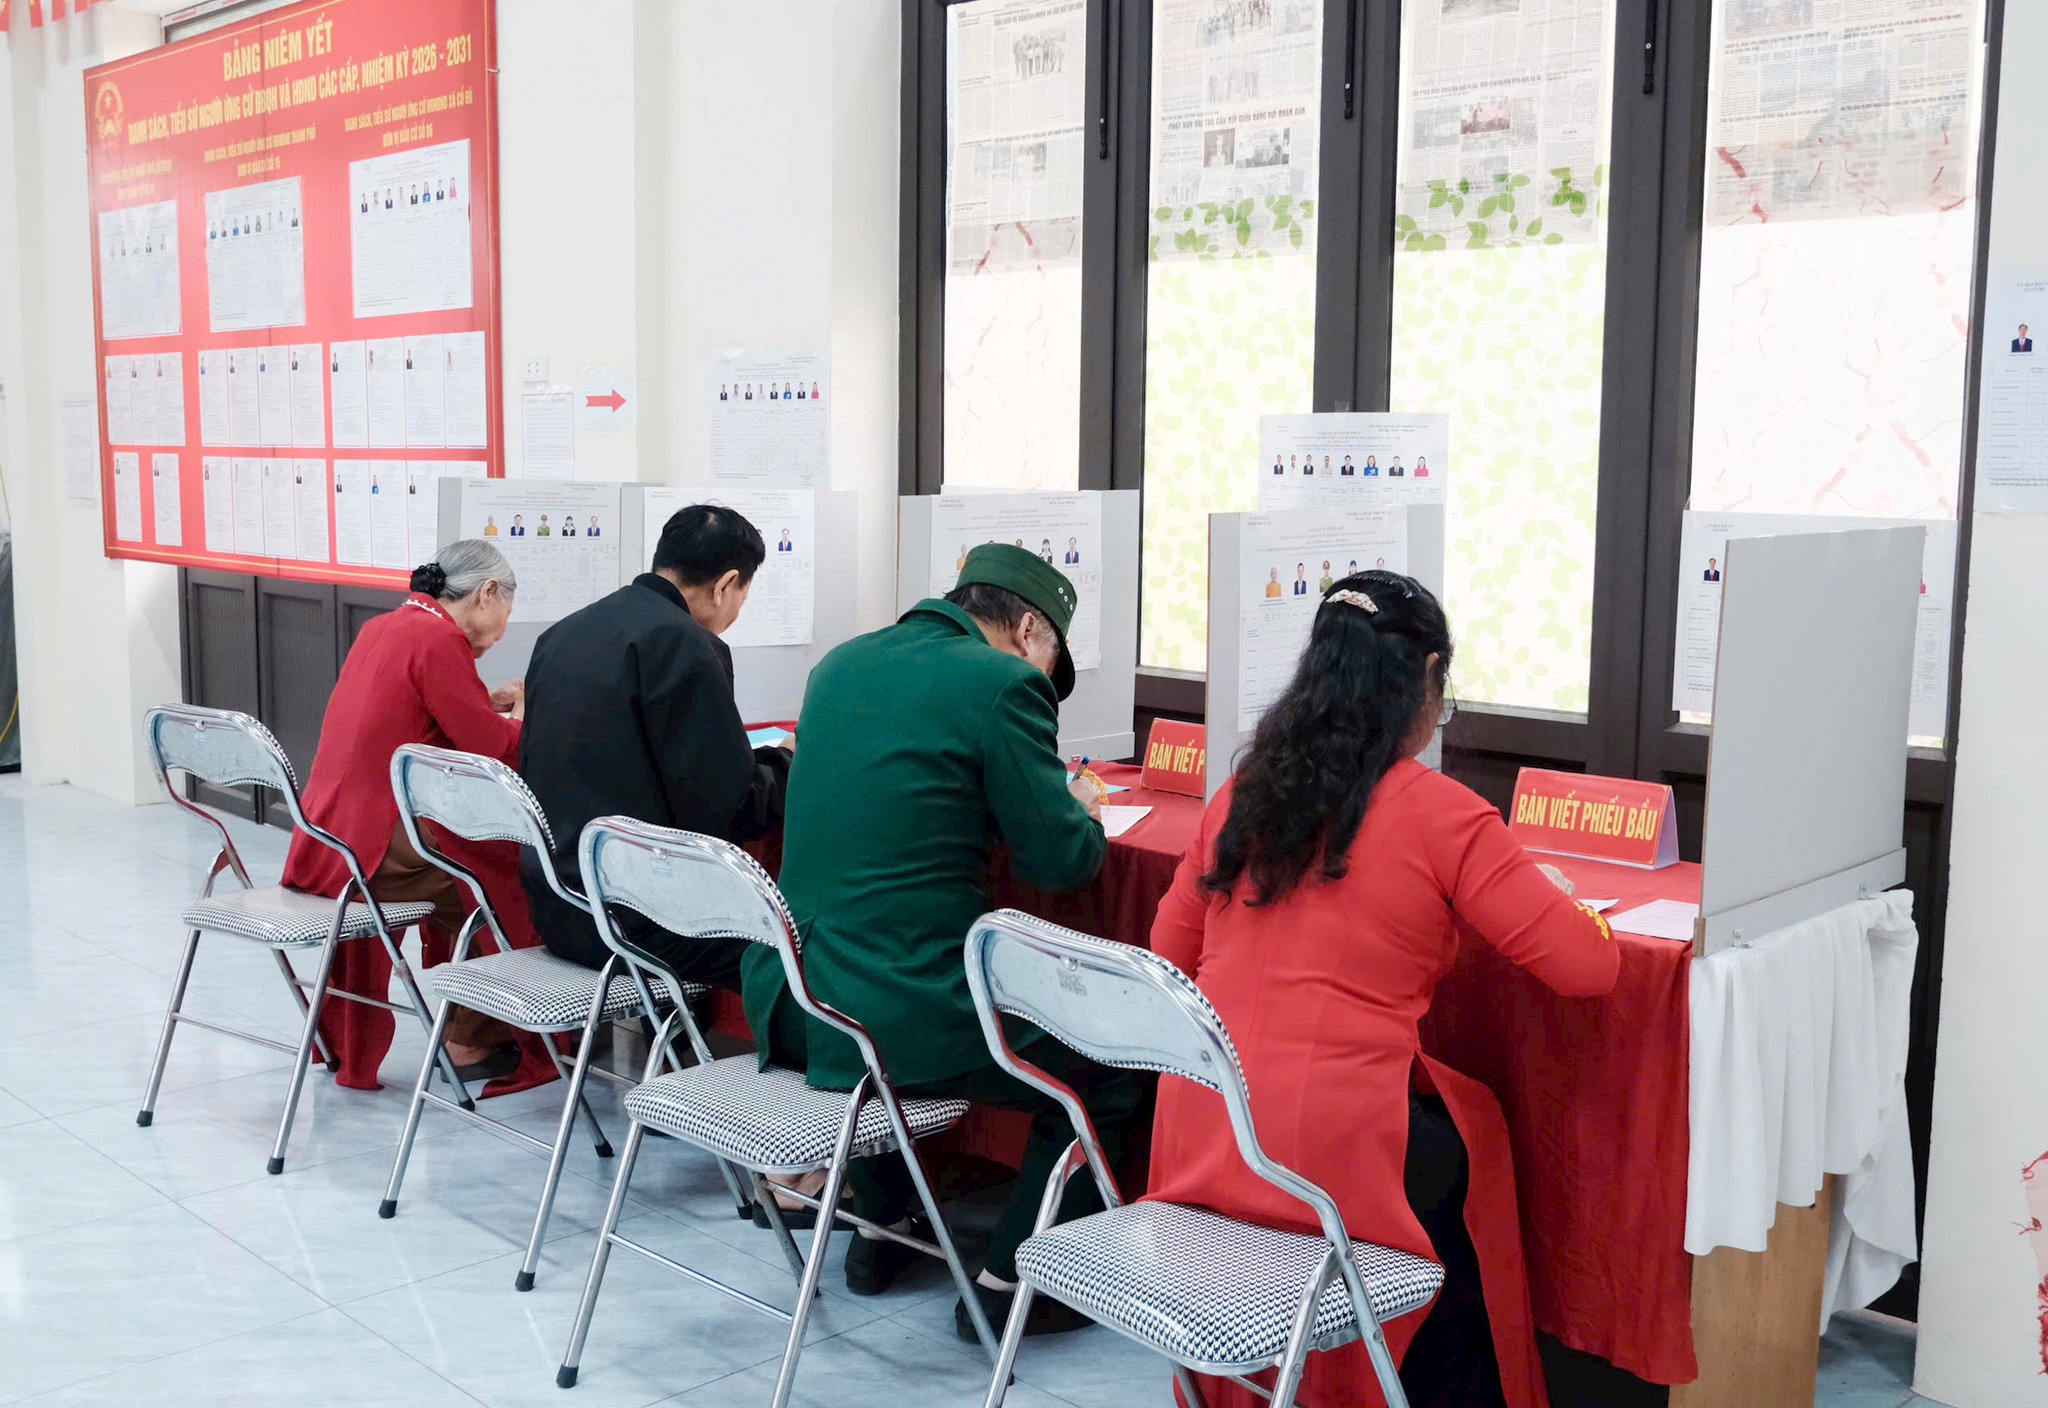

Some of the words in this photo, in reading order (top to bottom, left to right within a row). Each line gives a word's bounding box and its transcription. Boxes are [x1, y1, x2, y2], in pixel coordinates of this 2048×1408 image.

[223, 39, 261, 81] BẢNG
[263, 28, 302, 69] NIÊM
[305, 12, 333, 58] YẾT
[128, 117, 148, 145] DANH
[279, 78, 291, 109] VÀ
[318, 66, 338, 99] CÁC
[339, 55, 360, 94] CẤP,
[361, 51, 394, 91] NHIỆM
[411, 43, 437, 76] 2026
[446, 33, 473, 67] 2031
[1148, 737, 1174, 771] BÀN
[1173, 738, 1198, 774] VIẾT
[1196, 748, 1205, 775] P
[1516, 788, 1548, 826] BÀN
[1549, 789, 1581, 830] VIẾT
[1580, 795, 1625, 837] PHIẾU
[1625, 798, 1658, 841] BẦU
